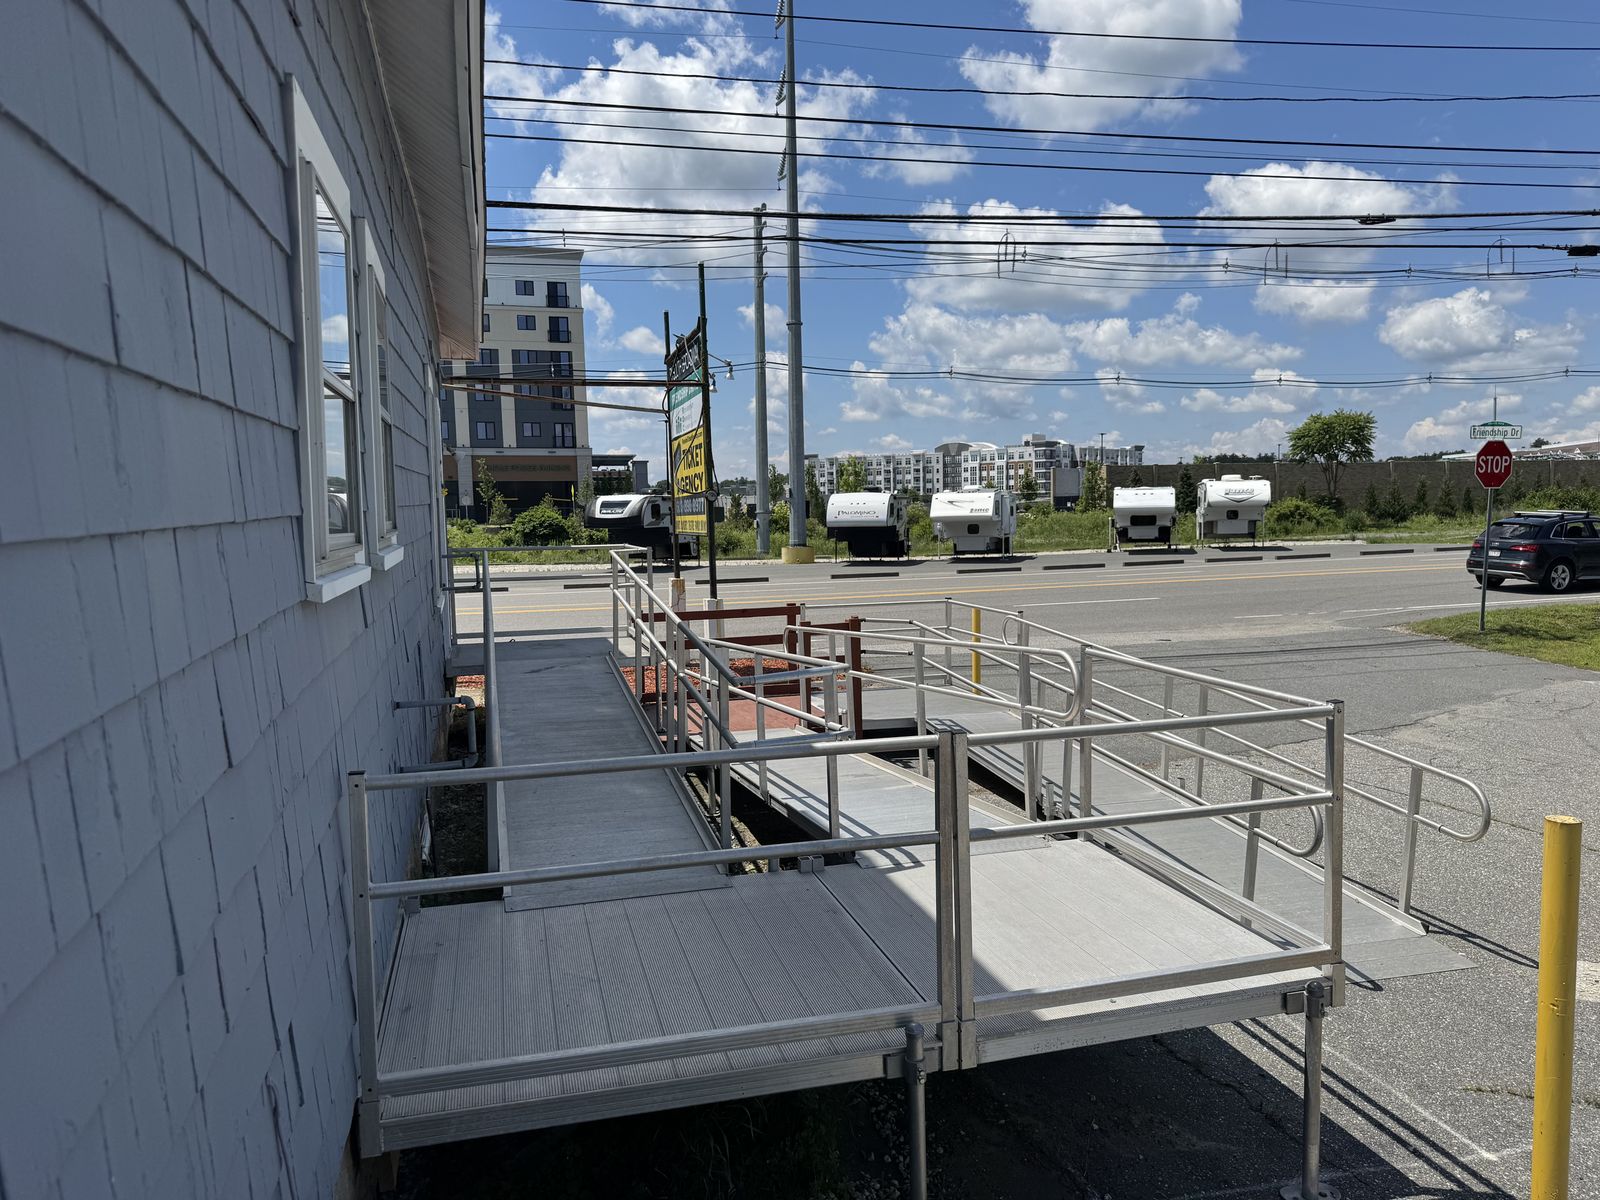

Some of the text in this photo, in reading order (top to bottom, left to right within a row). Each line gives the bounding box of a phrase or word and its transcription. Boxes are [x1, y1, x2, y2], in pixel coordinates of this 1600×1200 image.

[1472, 427, 1519, 438] Friendship Dr
[682, 443, 703, 471] TICKET
[1477, 455, 1510, 474] STOP
[677, 472, 704, 496] AGENCY
